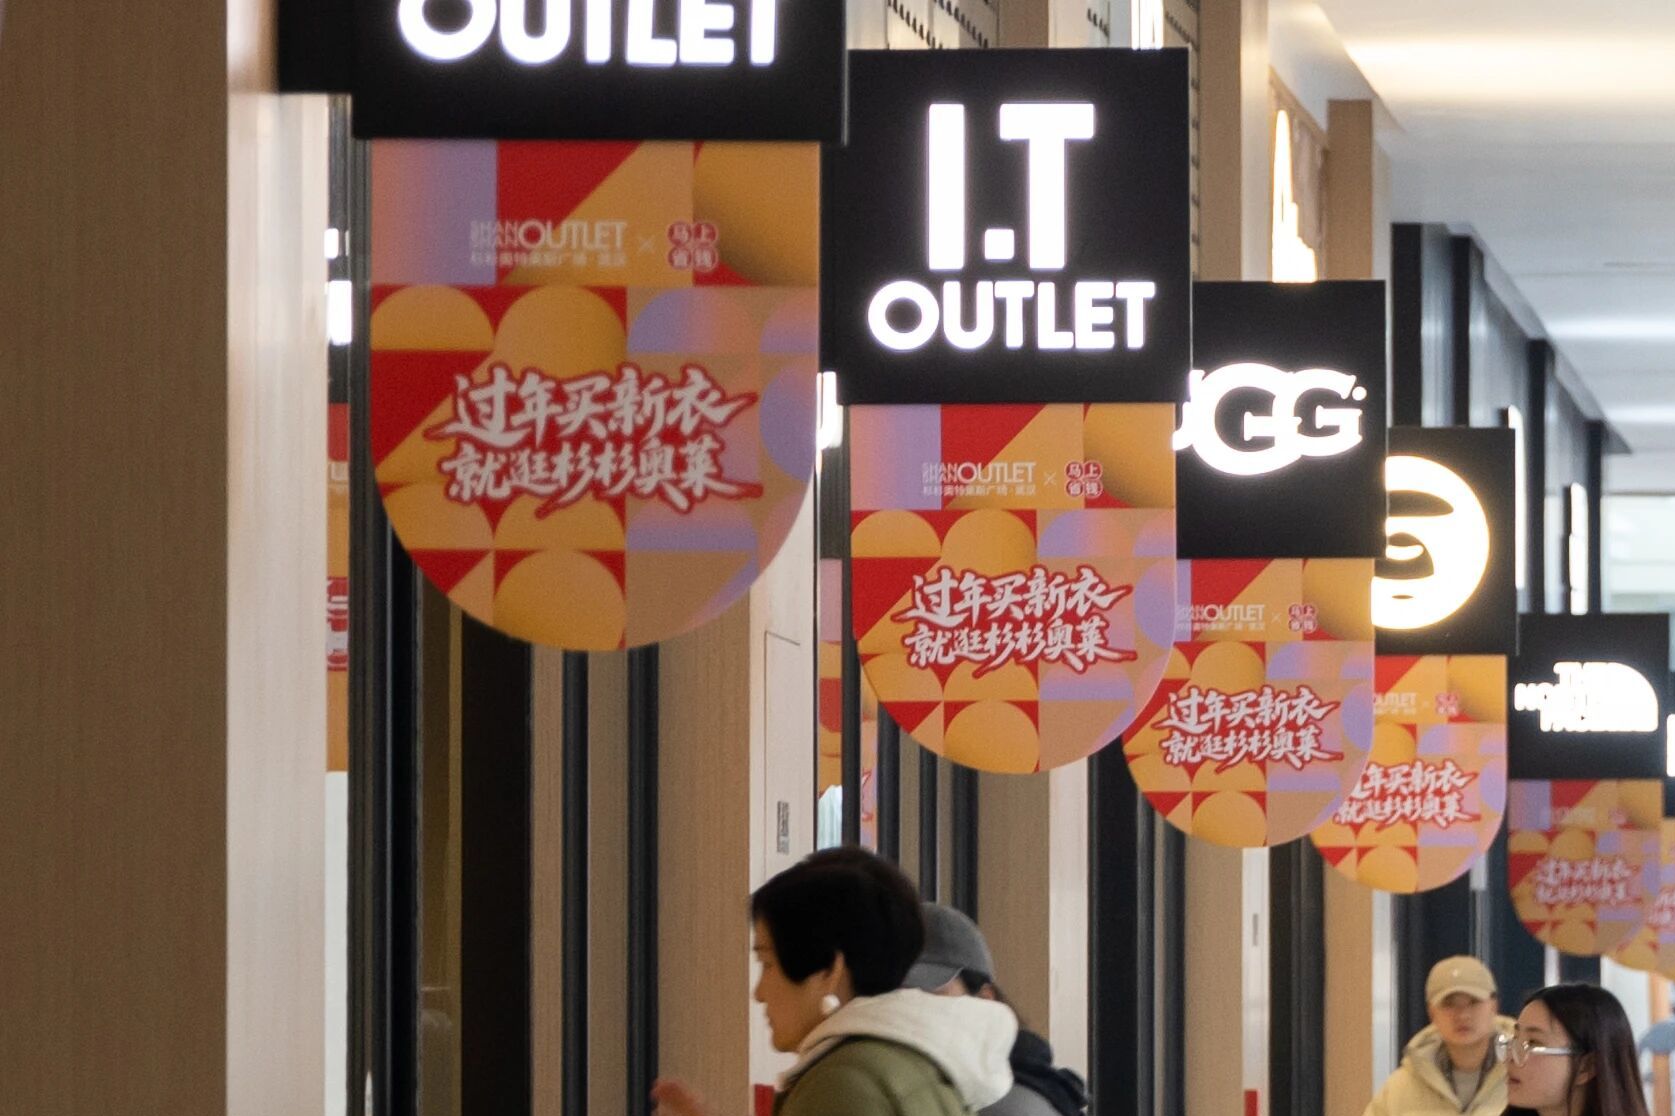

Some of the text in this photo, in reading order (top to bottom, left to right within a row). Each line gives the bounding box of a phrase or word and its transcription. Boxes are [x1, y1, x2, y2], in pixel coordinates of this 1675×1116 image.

[928, 103, 1095, 270] I.T
[518, 220, 628, 251] OUTLET
[868, 280, 1156, 350] OUTLET
[443, 366, 752, 448] 过年买新衣
[441, 435, 742, 510] 就逛杉杉奥莱
[957, 462, 1036, 483] OUTLET
[904, 568, 1128, 628] 过年买新衣
[905, 615, 1122, 671] 就逛杉杉奥莱
[1156, 687, 1336, 734] 过年买新衣
[1162, 724, 1333, 769] 就逛杉杉奥莱
